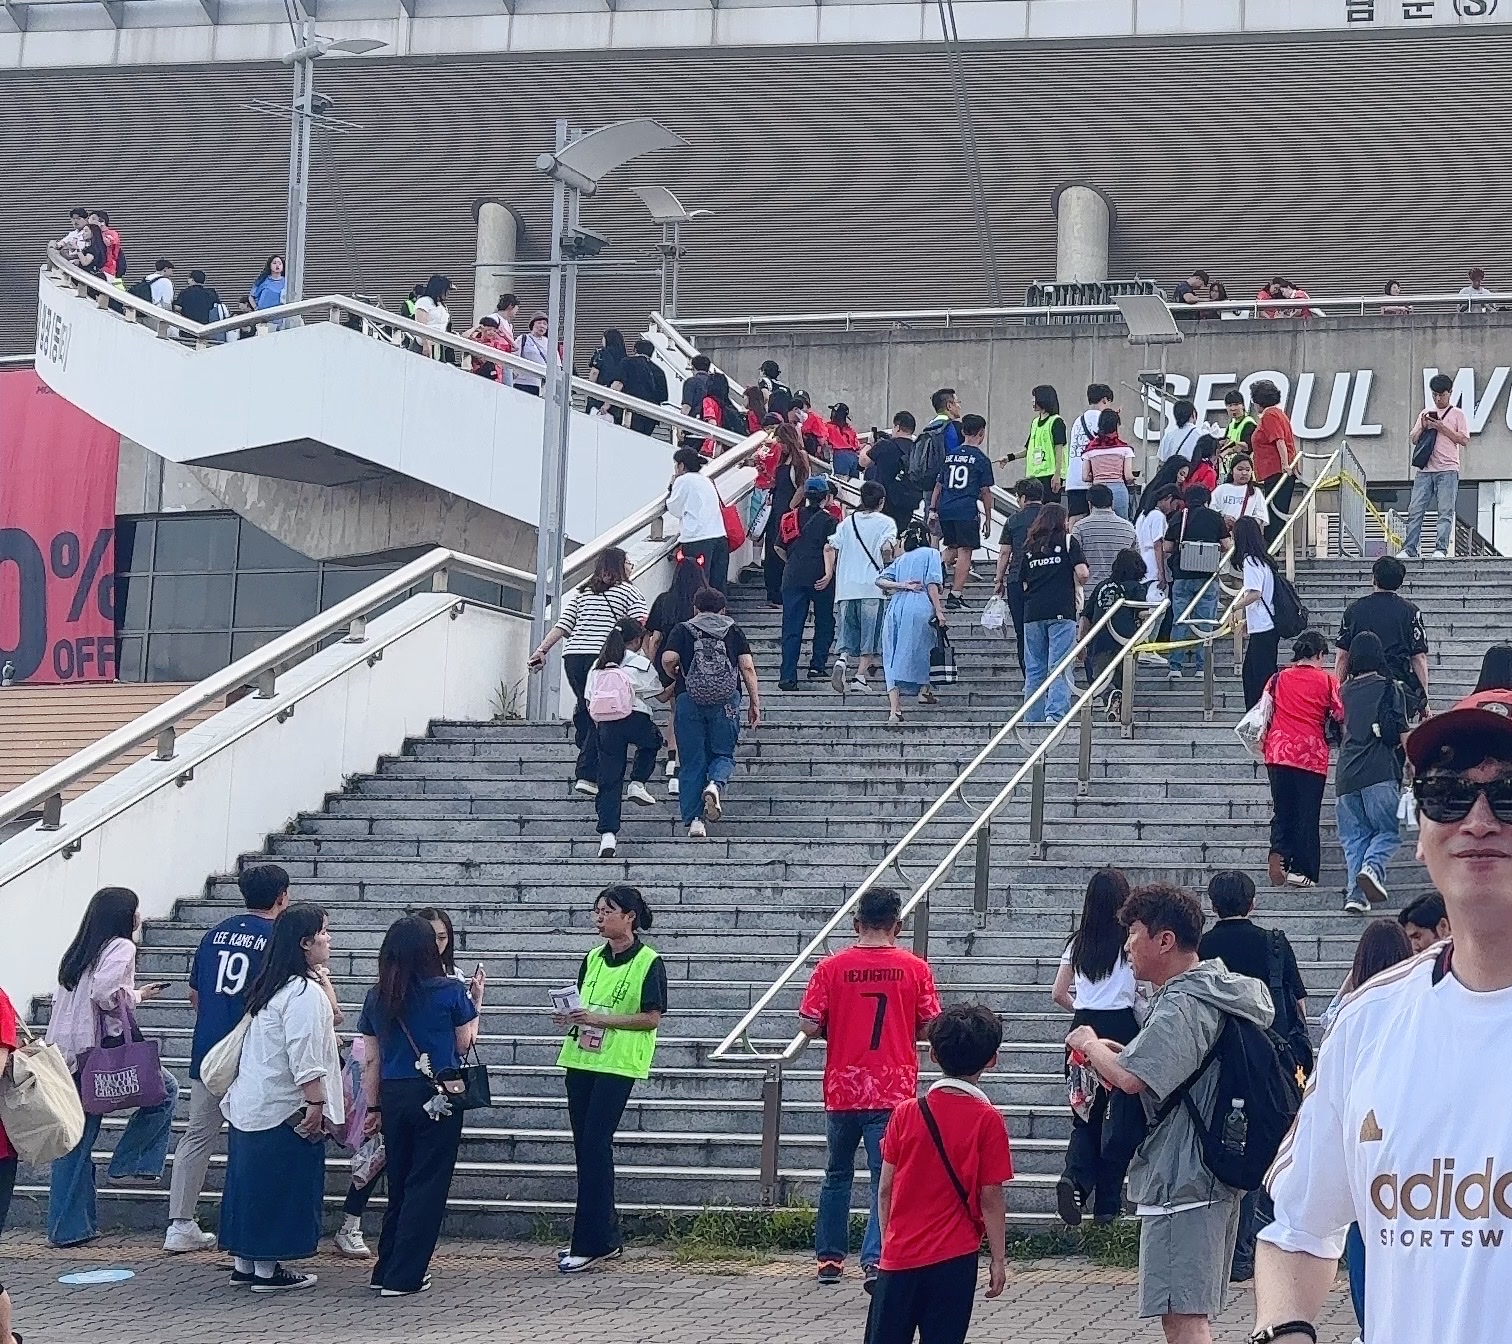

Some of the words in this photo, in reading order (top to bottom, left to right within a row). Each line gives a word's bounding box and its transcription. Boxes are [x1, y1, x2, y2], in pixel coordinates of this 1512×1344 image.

[949, 465, 969, 489] 19
[53, 637, 115, 679] OFF
[215, 950, 250, 995] 19
[859, 992, 888, 1051] 7
